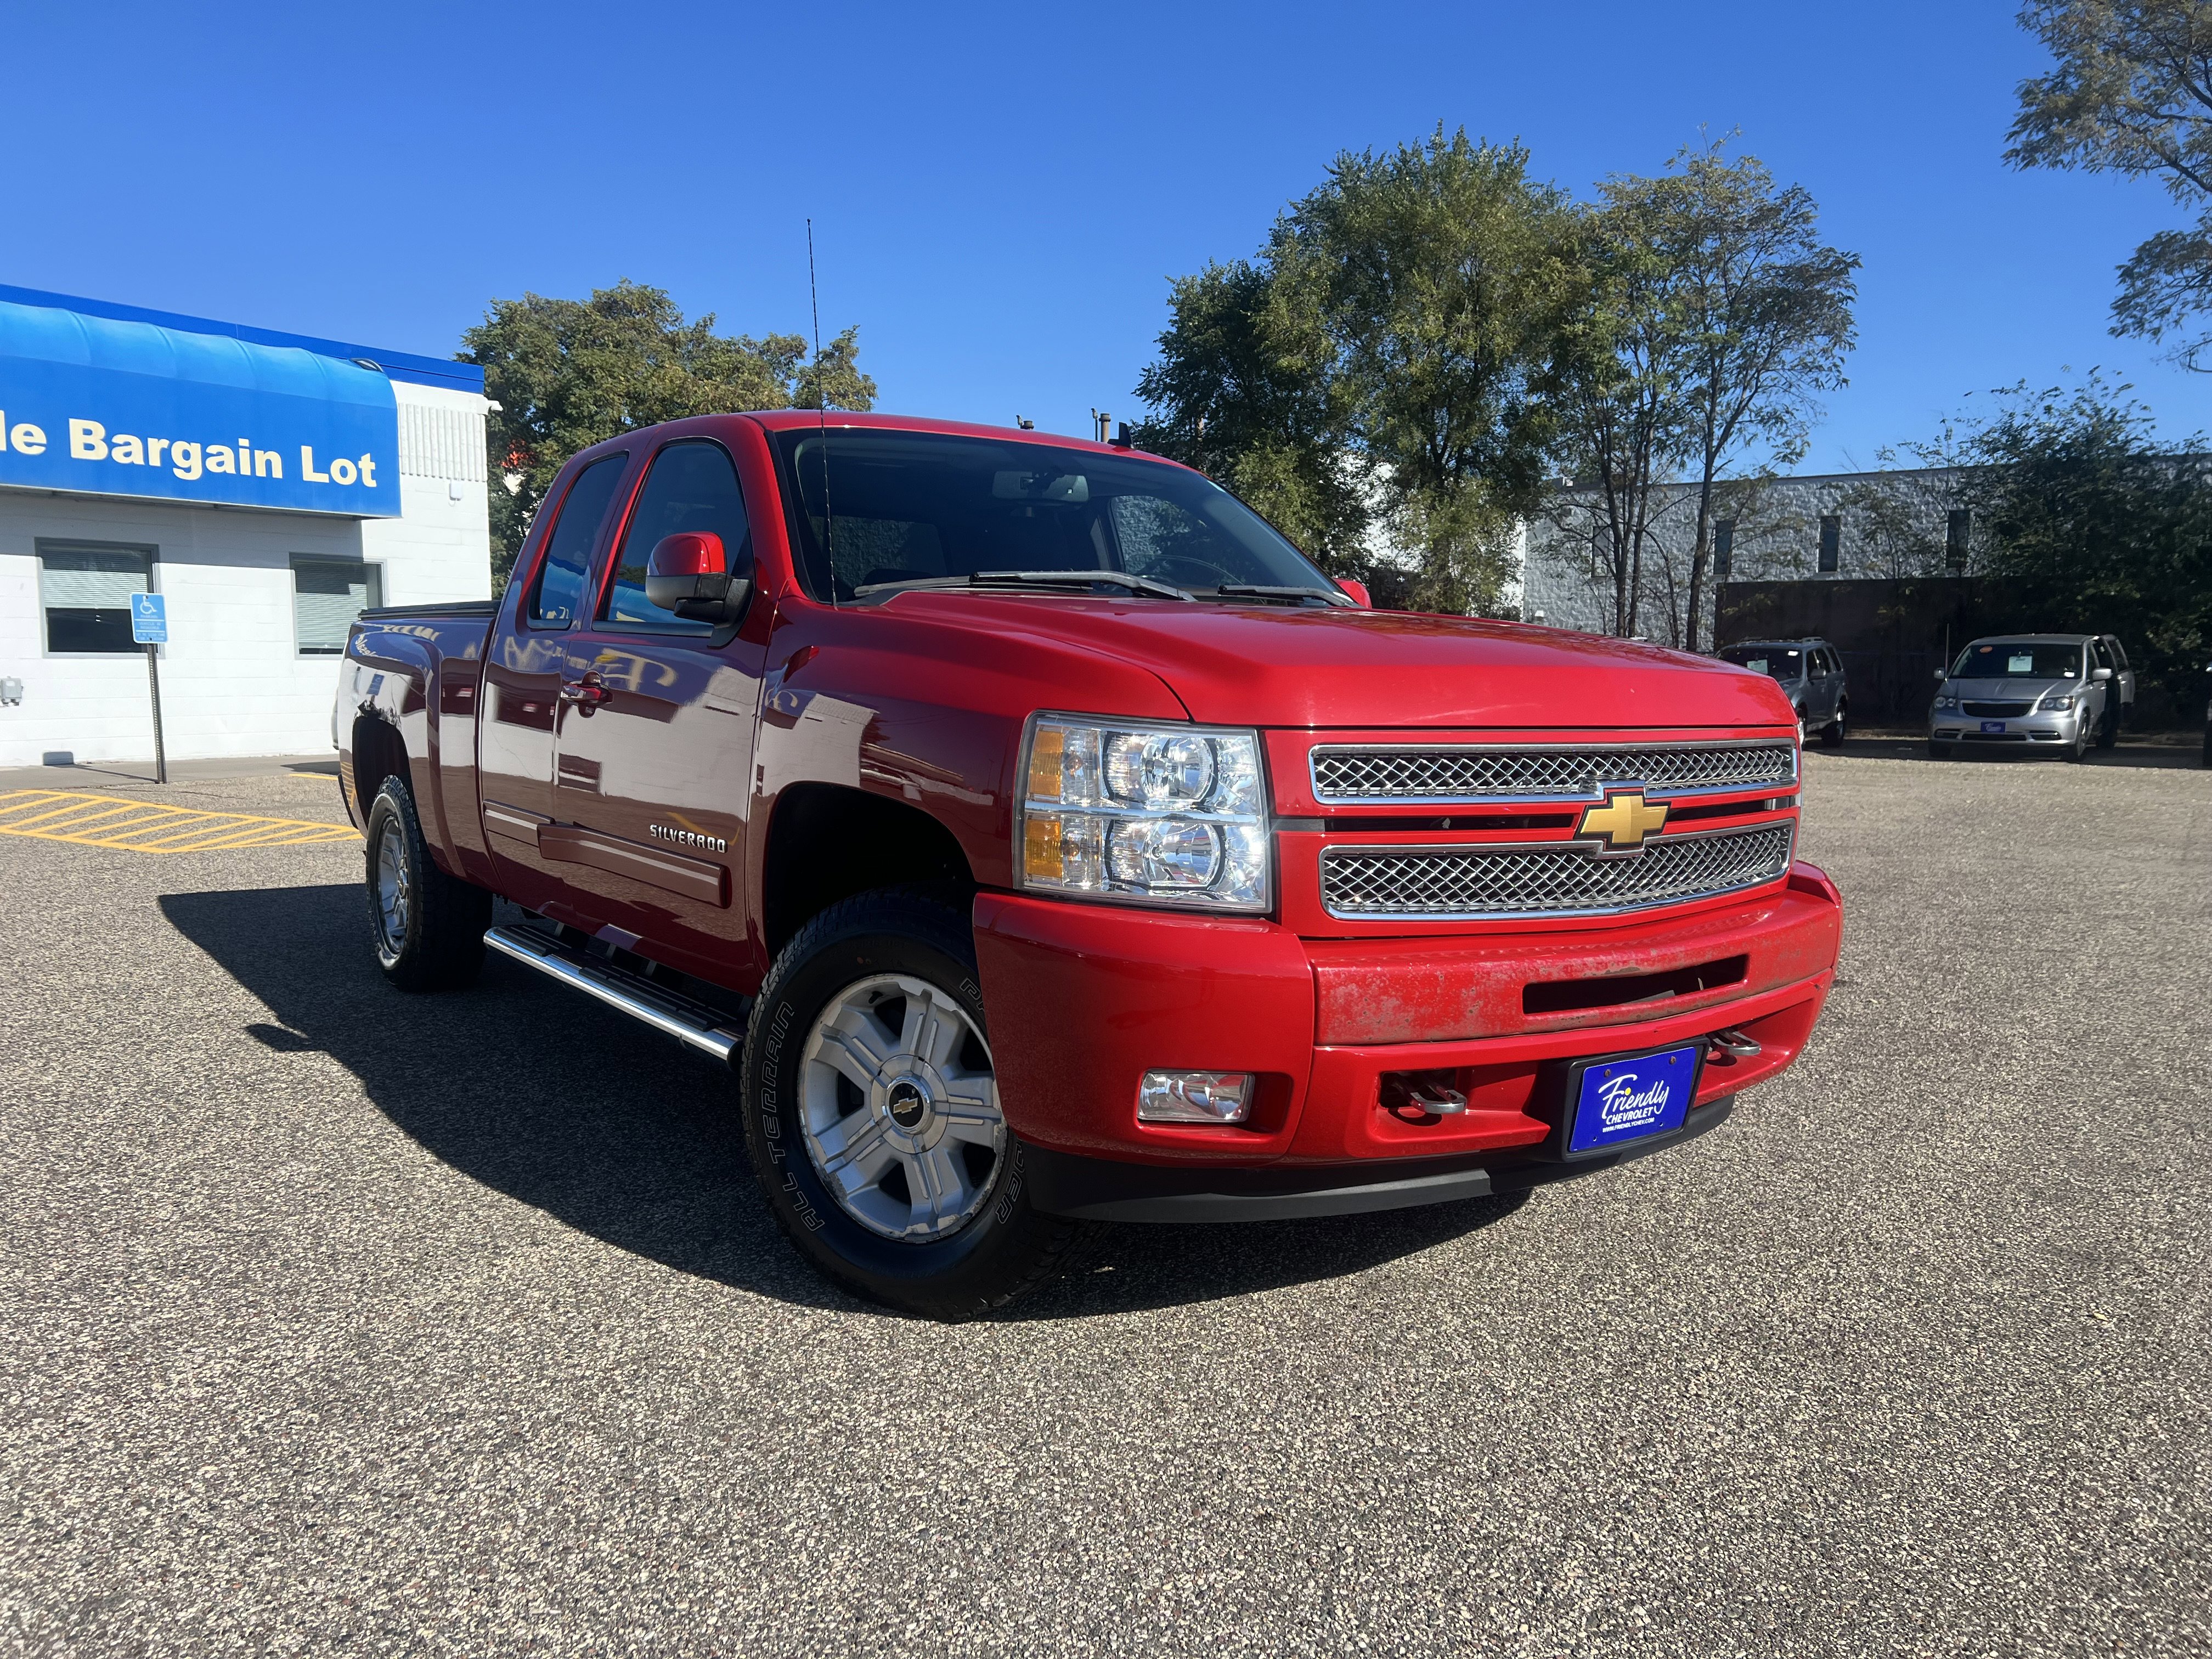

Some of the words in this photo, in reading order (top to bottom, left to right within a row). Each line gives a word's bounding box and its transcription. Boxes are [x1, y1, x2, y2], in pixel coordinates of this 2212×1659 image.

[69, 418, 283, 480] Bargain
[301, 445, 377, 487] Lot
[650, 824, 726, 853] SILVERADO
[761, 1001, 794, 1164] TERRAIN
[1598, 1074, 1669, 1119] Friendly
[1606, 1107, 1654, 1125] CHEVROLET
[782, 1171, 825, 1231] ALL
